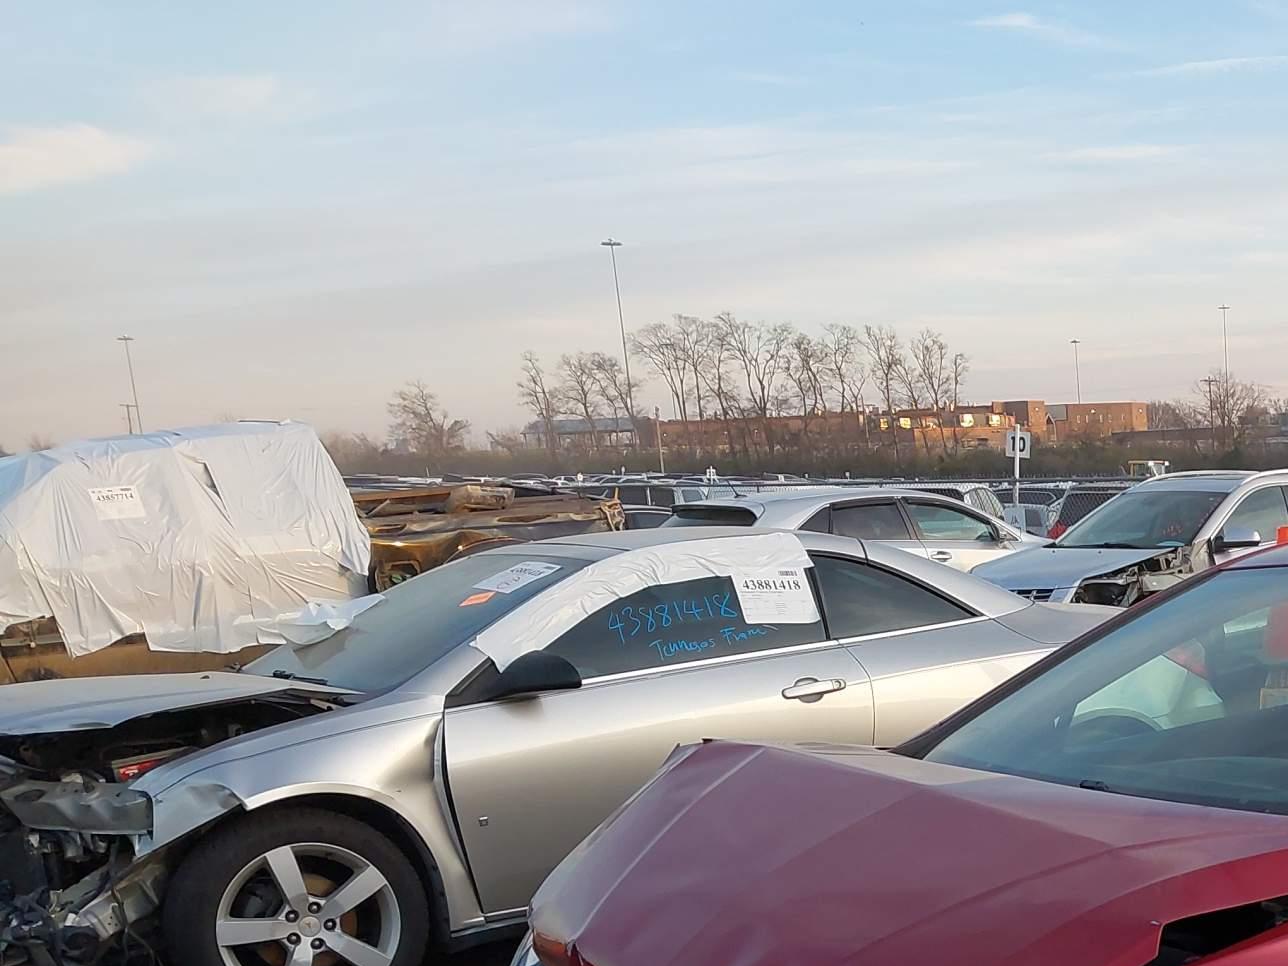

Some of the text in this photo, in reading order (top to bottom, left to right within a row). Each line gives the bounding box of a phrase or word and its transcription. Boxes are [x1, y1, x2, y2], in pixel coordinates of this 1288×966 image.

[1011, 436, 1026, 453] 10
[742, 579, 801, 591] 43881418
[607, 591, 737, 647] 43881418
